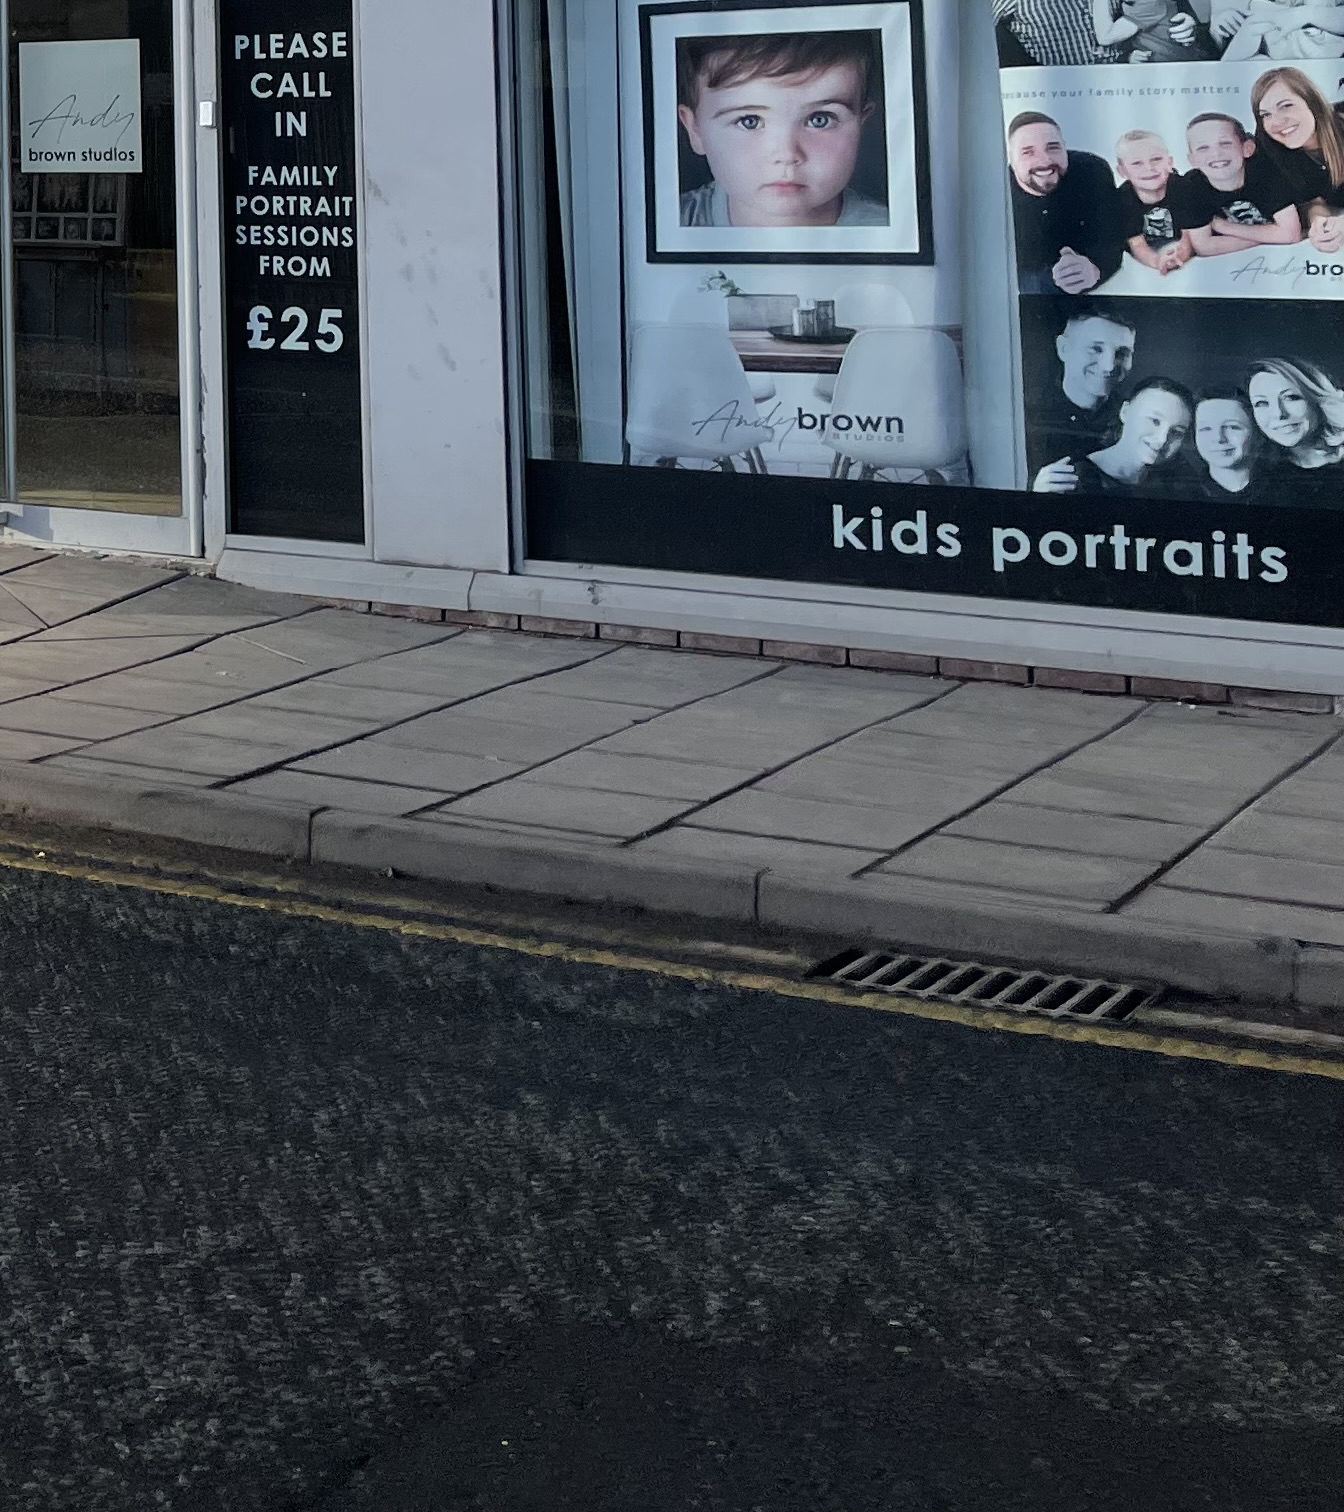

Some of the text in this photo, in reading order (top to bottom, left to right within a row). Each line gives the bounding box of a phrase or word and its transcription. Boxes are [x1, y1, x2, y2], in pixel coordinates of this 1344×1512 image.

[234, 31, 348, 61] PLEASE
[250, 71, 331, 100] CALL
[1051, 90, 1082, 99] your
[1088, 87, 1133, 98] family
[1138, 87, 1176, 97] story
[1180, 85, 1240, 95] matters
[28, 94, 135, 144] Andy
[274, 110, 307, 138] IN
[28, 146, 135, 163] brown studios
[247, 164, 339, 188] FAMILY
[235, 194, 353, 218] PORTRAIT
[235, 225, 353, 248] SESSIONS
[259, 255, 330, 277] FROM
[1230, 255, 1306, 289] Andy
[246, 306, 344, 353] £25
[692, 399, 904, 452] Andy brown
[832, 433, 905, 443] STUDIOS
[832, 504, 1289, 584] kids portraits
